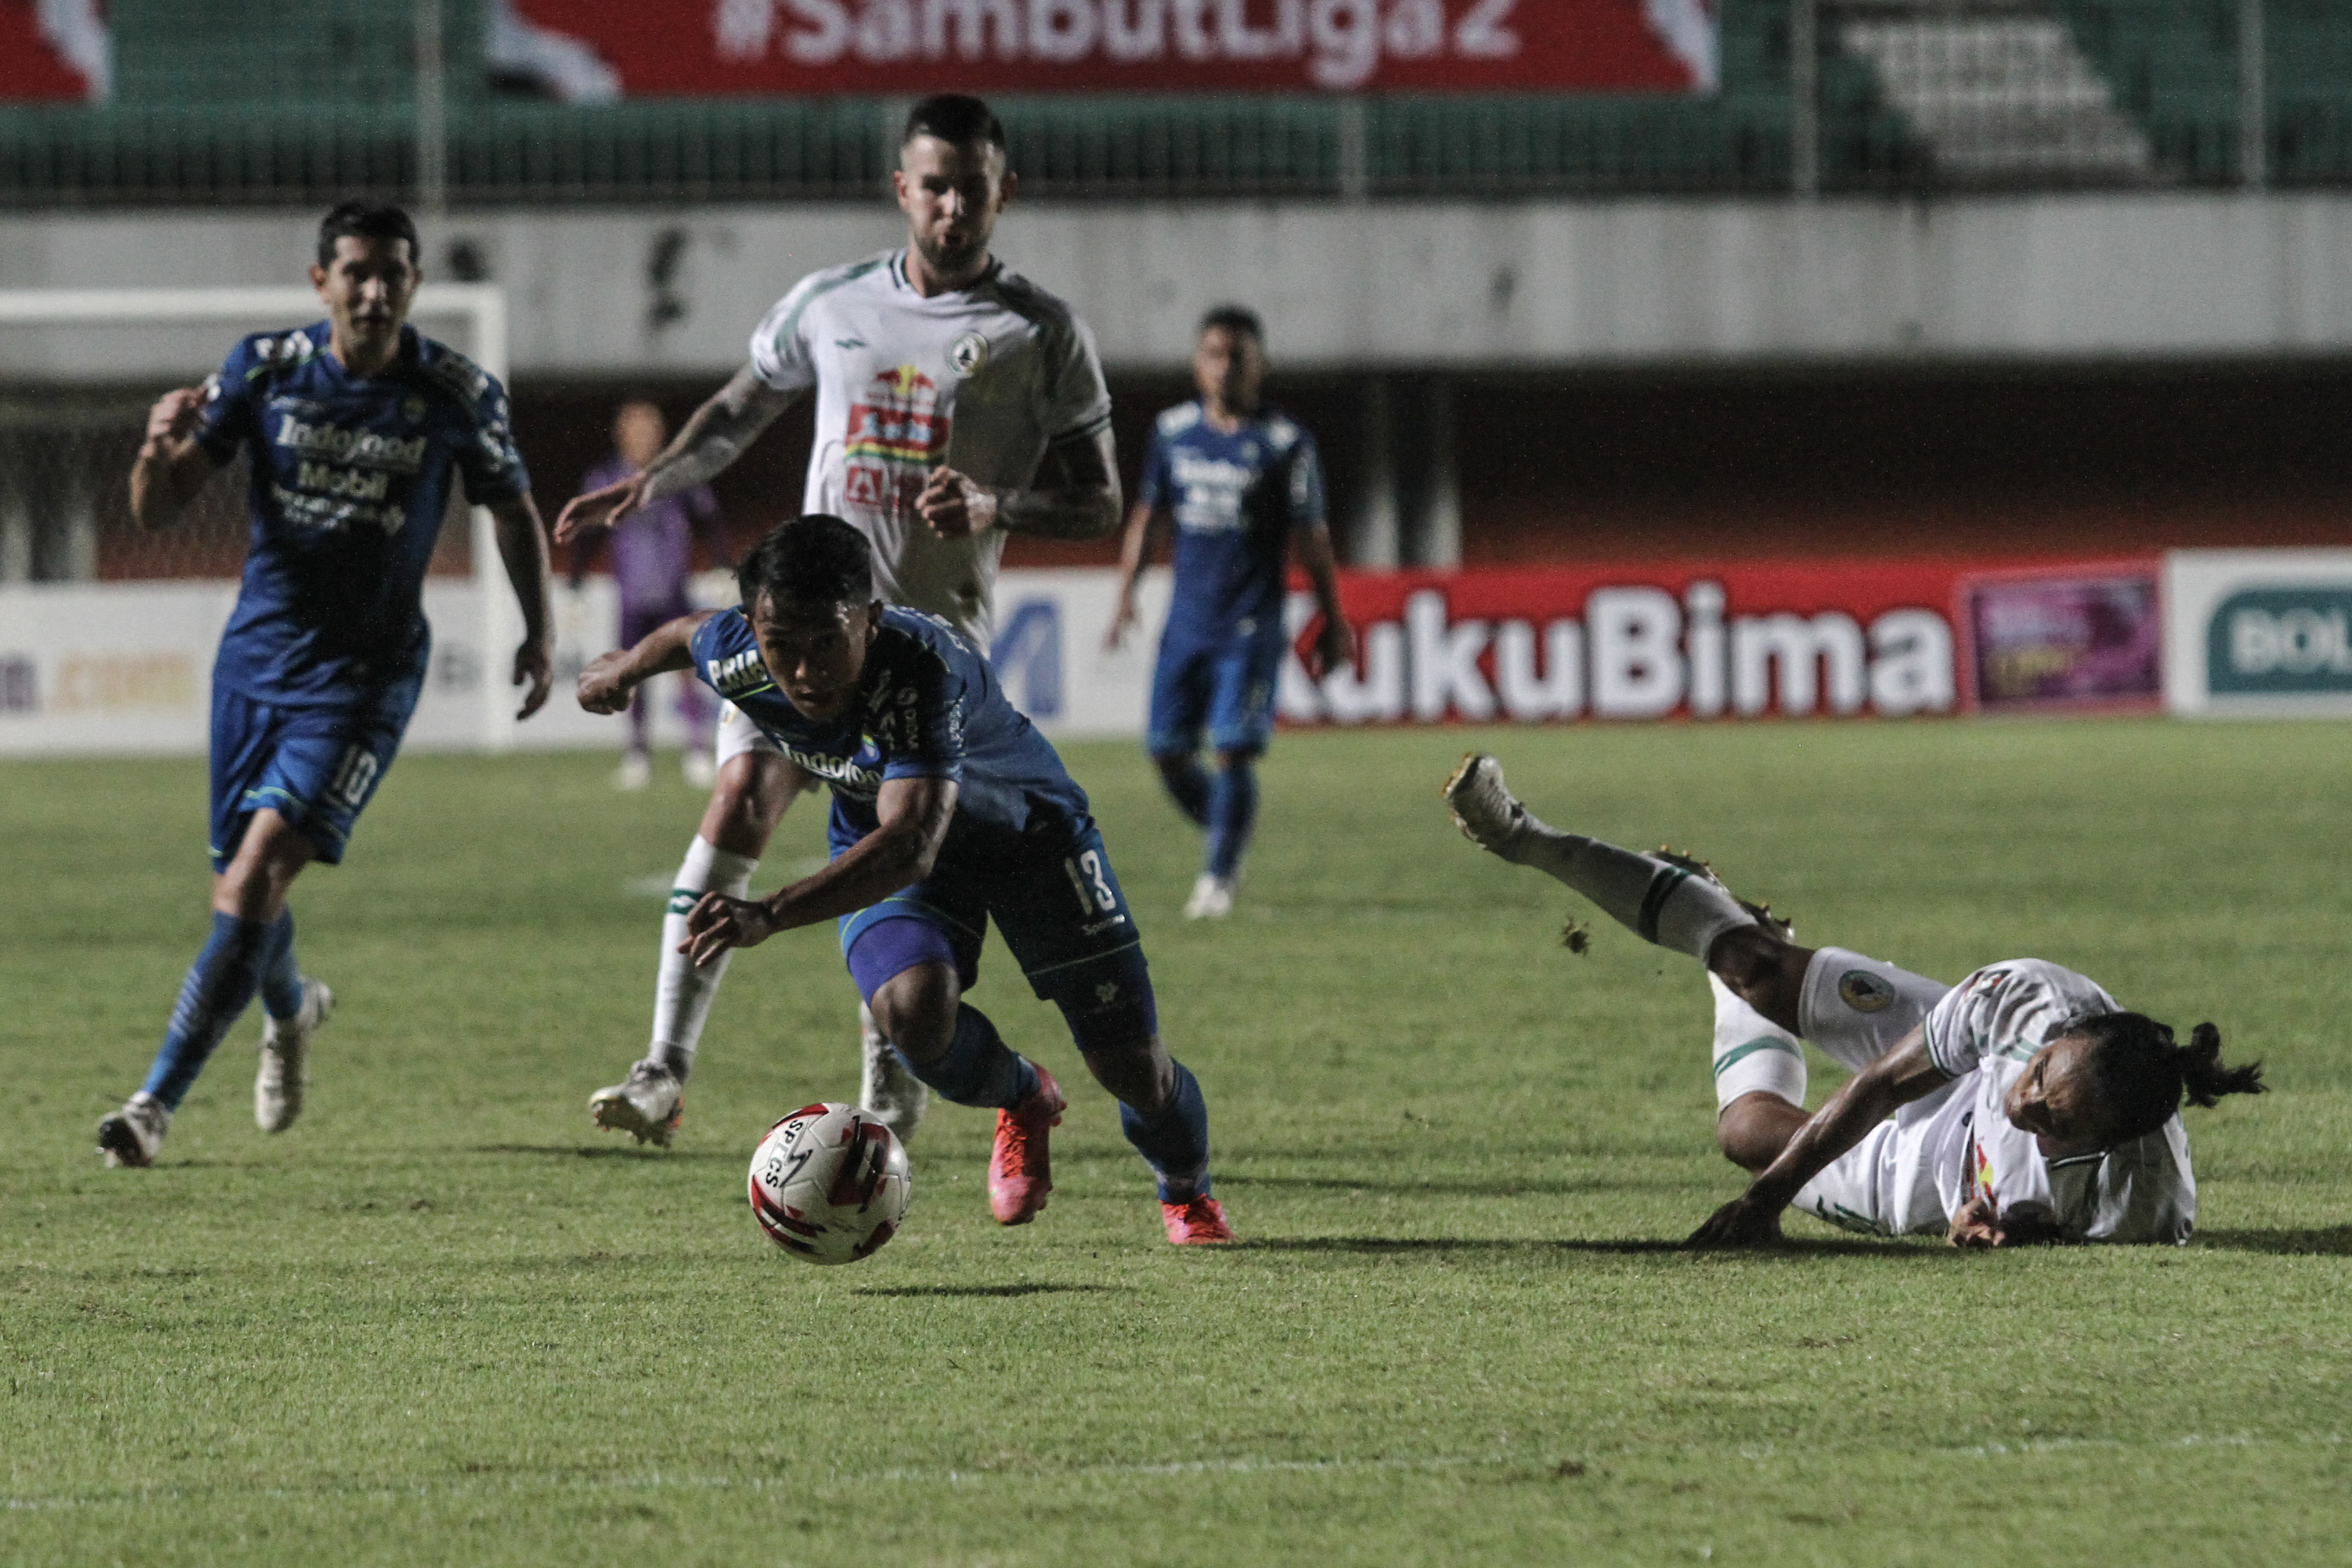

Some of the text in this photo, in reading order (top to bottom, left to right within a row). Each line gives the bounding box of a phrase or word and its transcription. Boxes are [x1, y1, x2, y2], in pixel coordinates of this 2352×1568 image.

[275, 413, 428, 462] Indofood
[297, 461, 389, 501] Mobil
[1279, 579, 1957, 726] KukuBima
[779, 738, 883, 785] Indofoo
[1065, 849, 1117, 917] 13
[765, 1119, 804, 1188] SPECS
